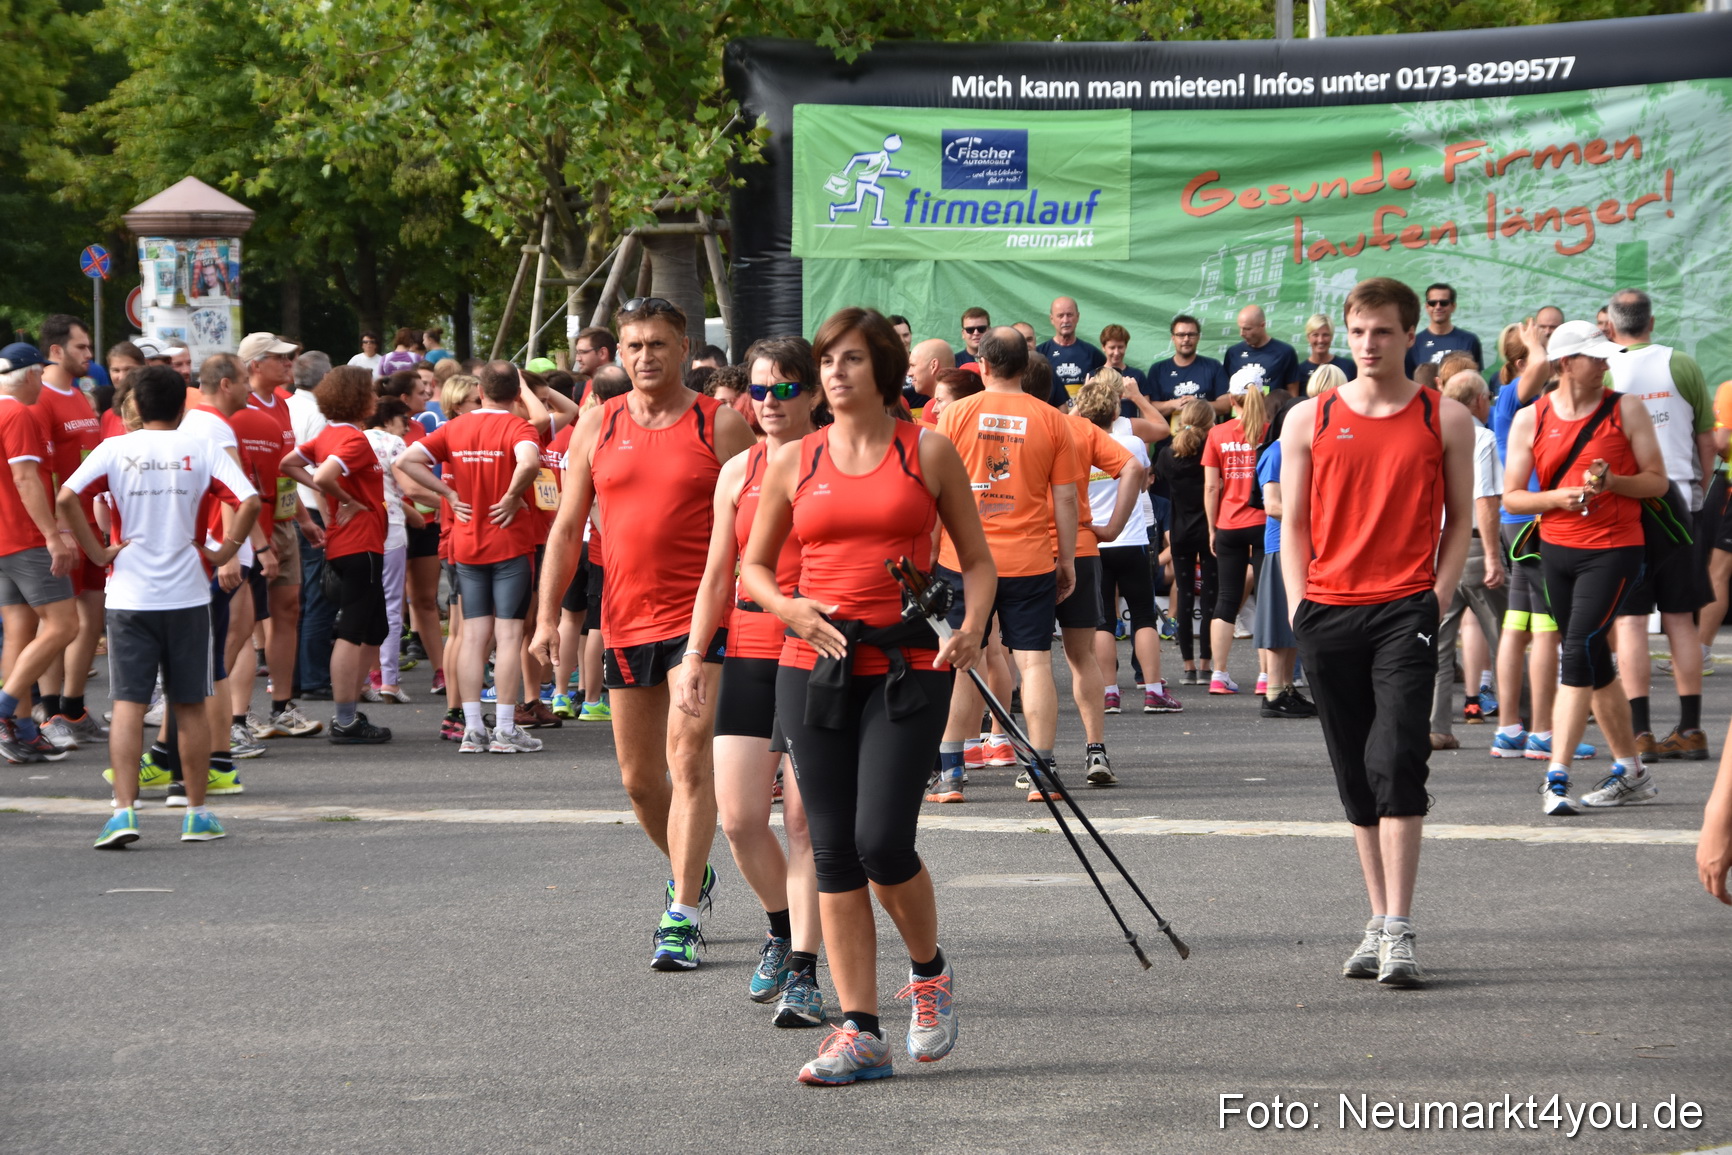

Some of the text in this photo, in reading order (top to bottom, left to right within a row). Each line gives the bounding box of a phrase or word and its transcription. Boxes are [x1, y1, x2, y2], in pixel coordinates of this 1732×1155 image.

[952, 56, 1576, 98] Mich kann man mieten! Infos unter 0173-8299577
[958, 144, 1016, 159] Fischer
[1181, 134, 1643, 217] Gesunde Firmen
[904, 188, 1102, 225] firmenlauf
[1293, 168, 1676, 264] laufen länger!
[1006, 229, 1094, 248] neumarkt
[982, 416, 1024, 431] OBI
[978, 432, 1025, 444] Running Team
[123, 455, 192, 474] Xplus1
[1226, 454, 1255, 465] CENTE
